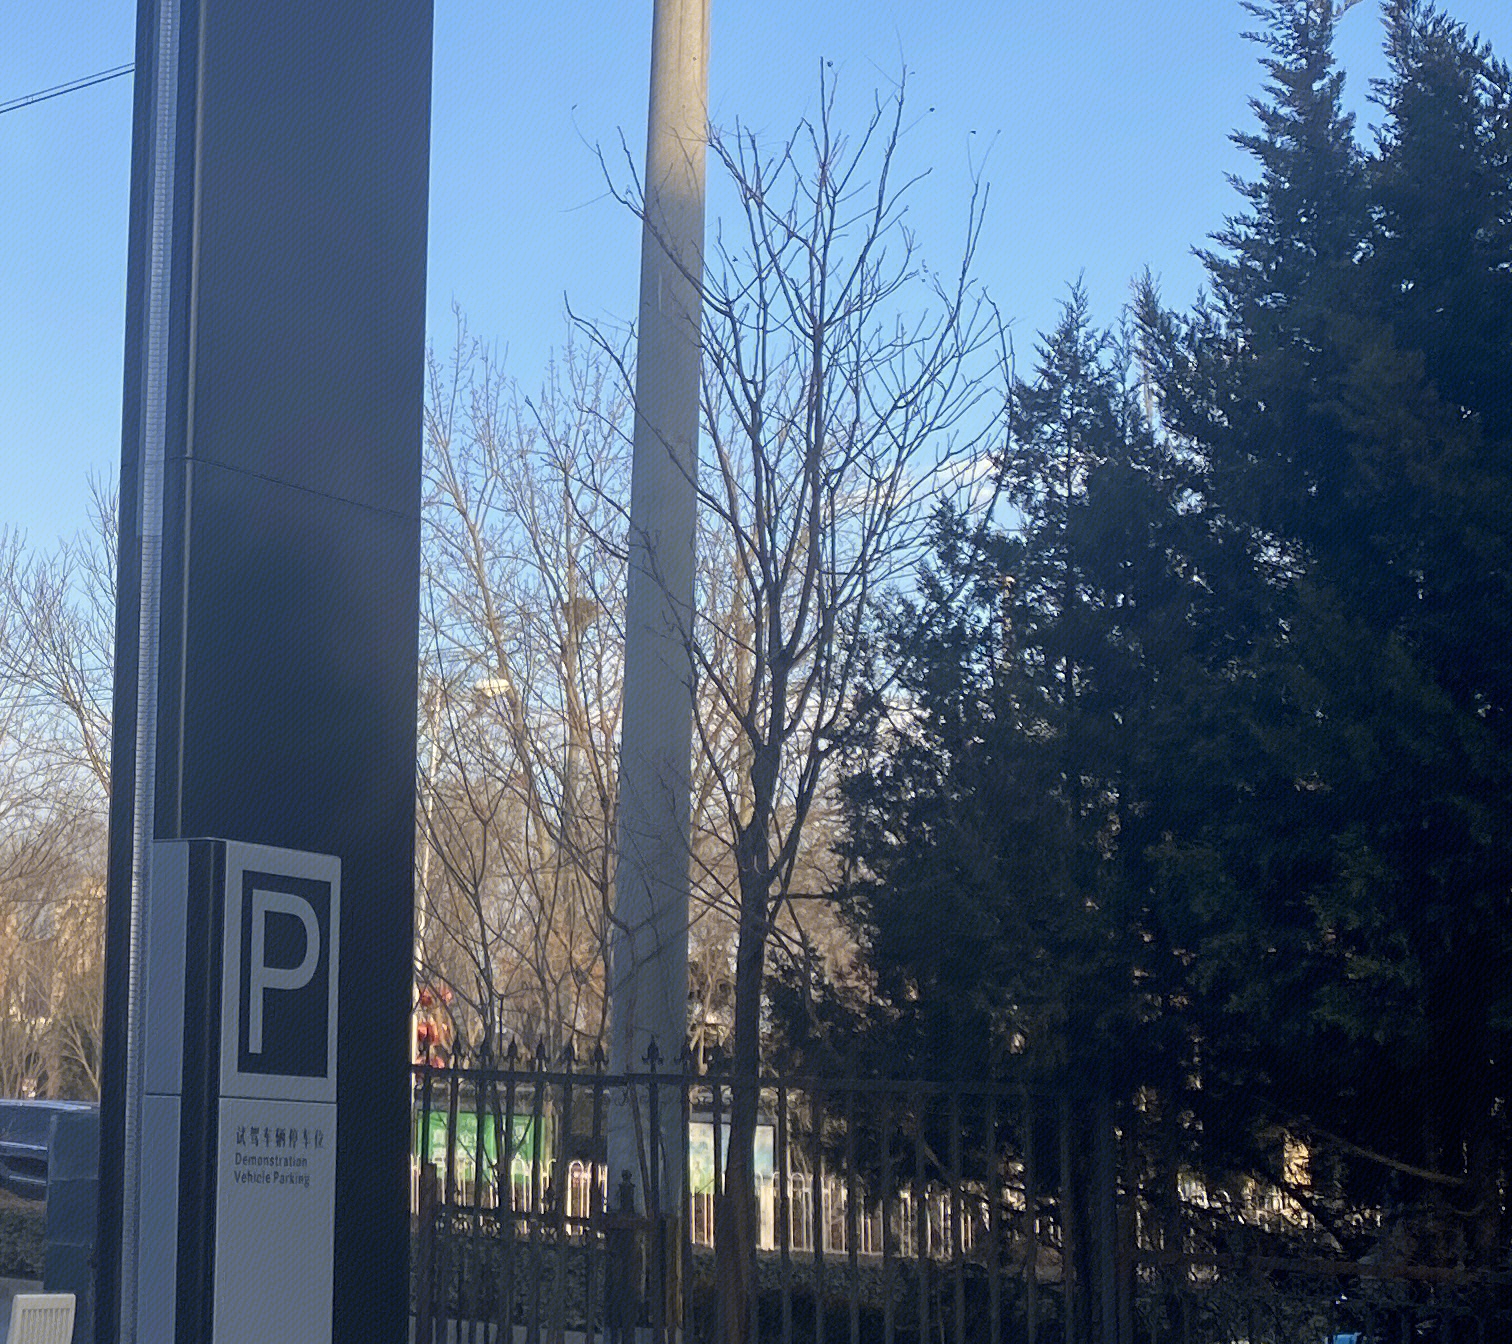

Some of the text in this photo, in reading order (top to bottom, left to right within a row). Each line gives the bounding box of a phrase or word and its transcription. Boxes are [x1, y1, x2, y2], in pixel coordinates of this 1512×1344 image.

[248, 888, 321, 1054] P
[235, 1152, 308, 1168] Demonstration
[234, 1170, 310, 1188] Vehicle Parking
